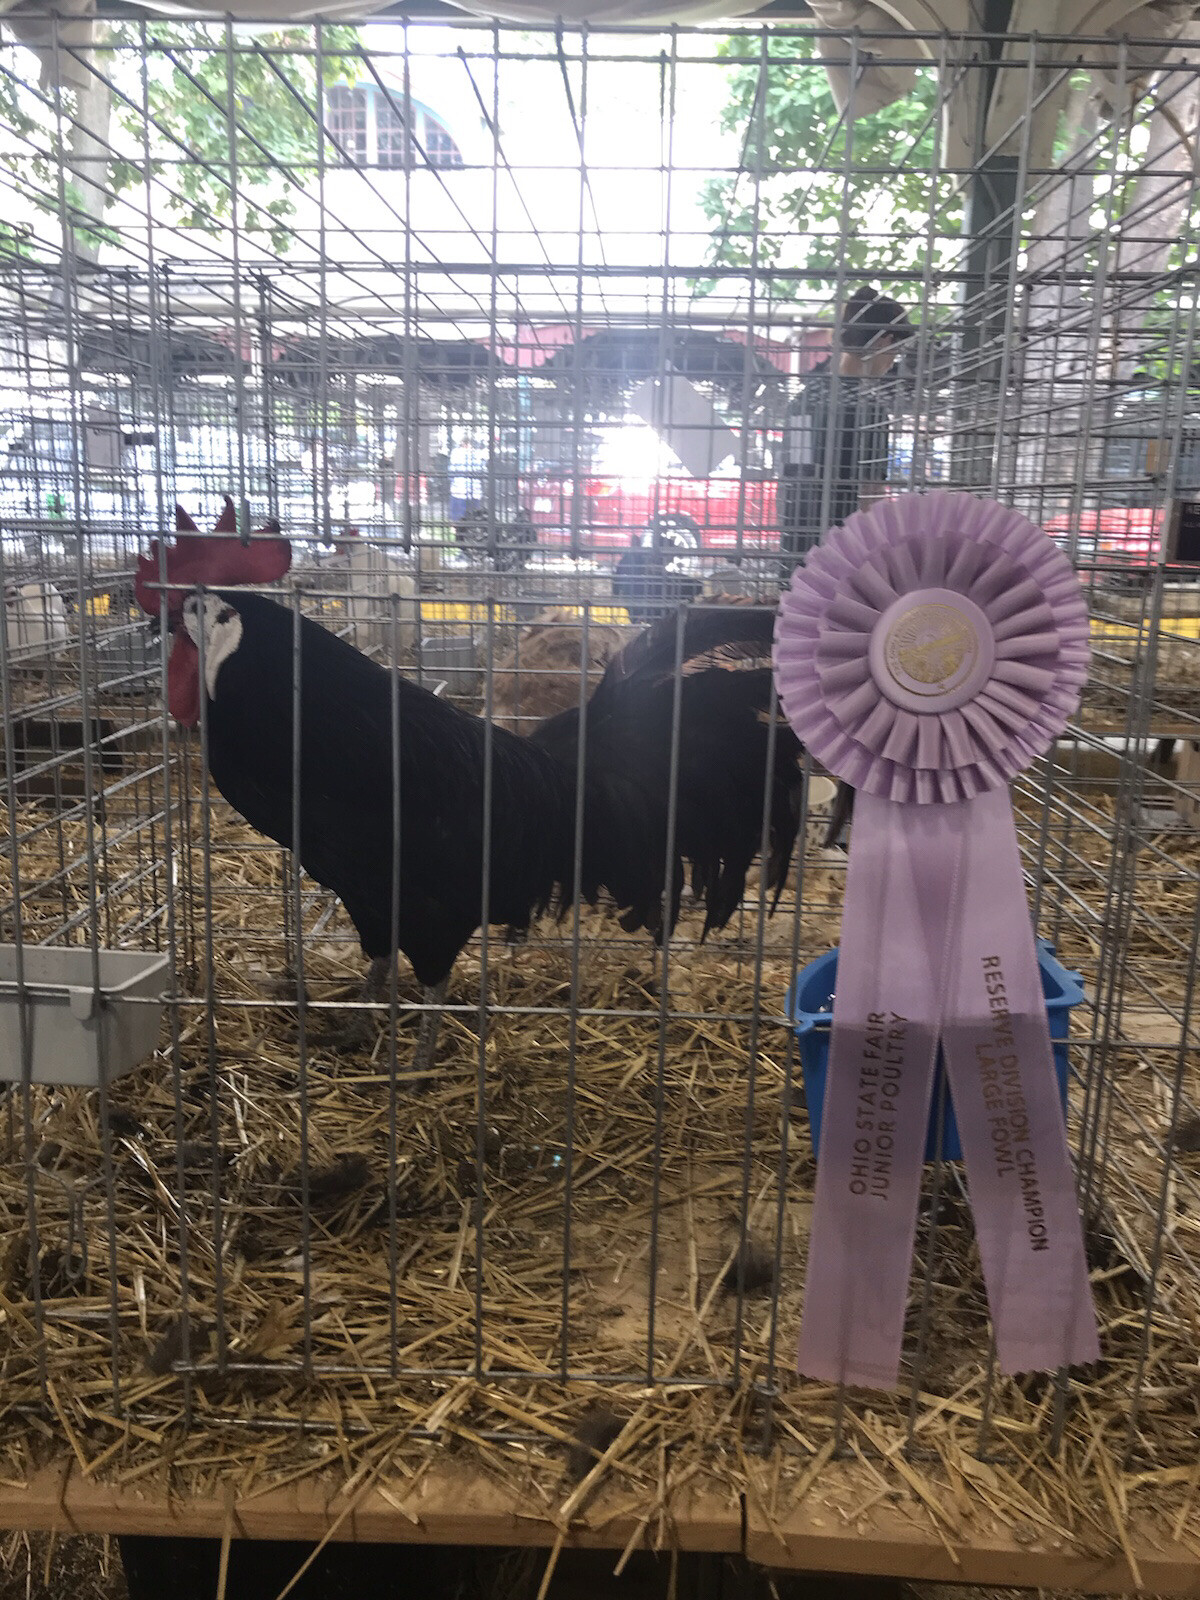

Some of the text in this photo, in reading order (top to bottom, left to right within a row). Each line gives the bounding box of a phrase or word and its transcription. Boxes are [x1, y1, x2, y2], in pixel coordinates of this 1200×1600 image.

[849, 1011, 886, 1195] OHIO STATE FAIR
[870, 1010, 908, 1200] JUNIOR POULTRY
[975, 1043, 1015, 1177] LARGE FOWL
[981, 955, 1050, 1252] RESERVE DIVISION CHAMPION
